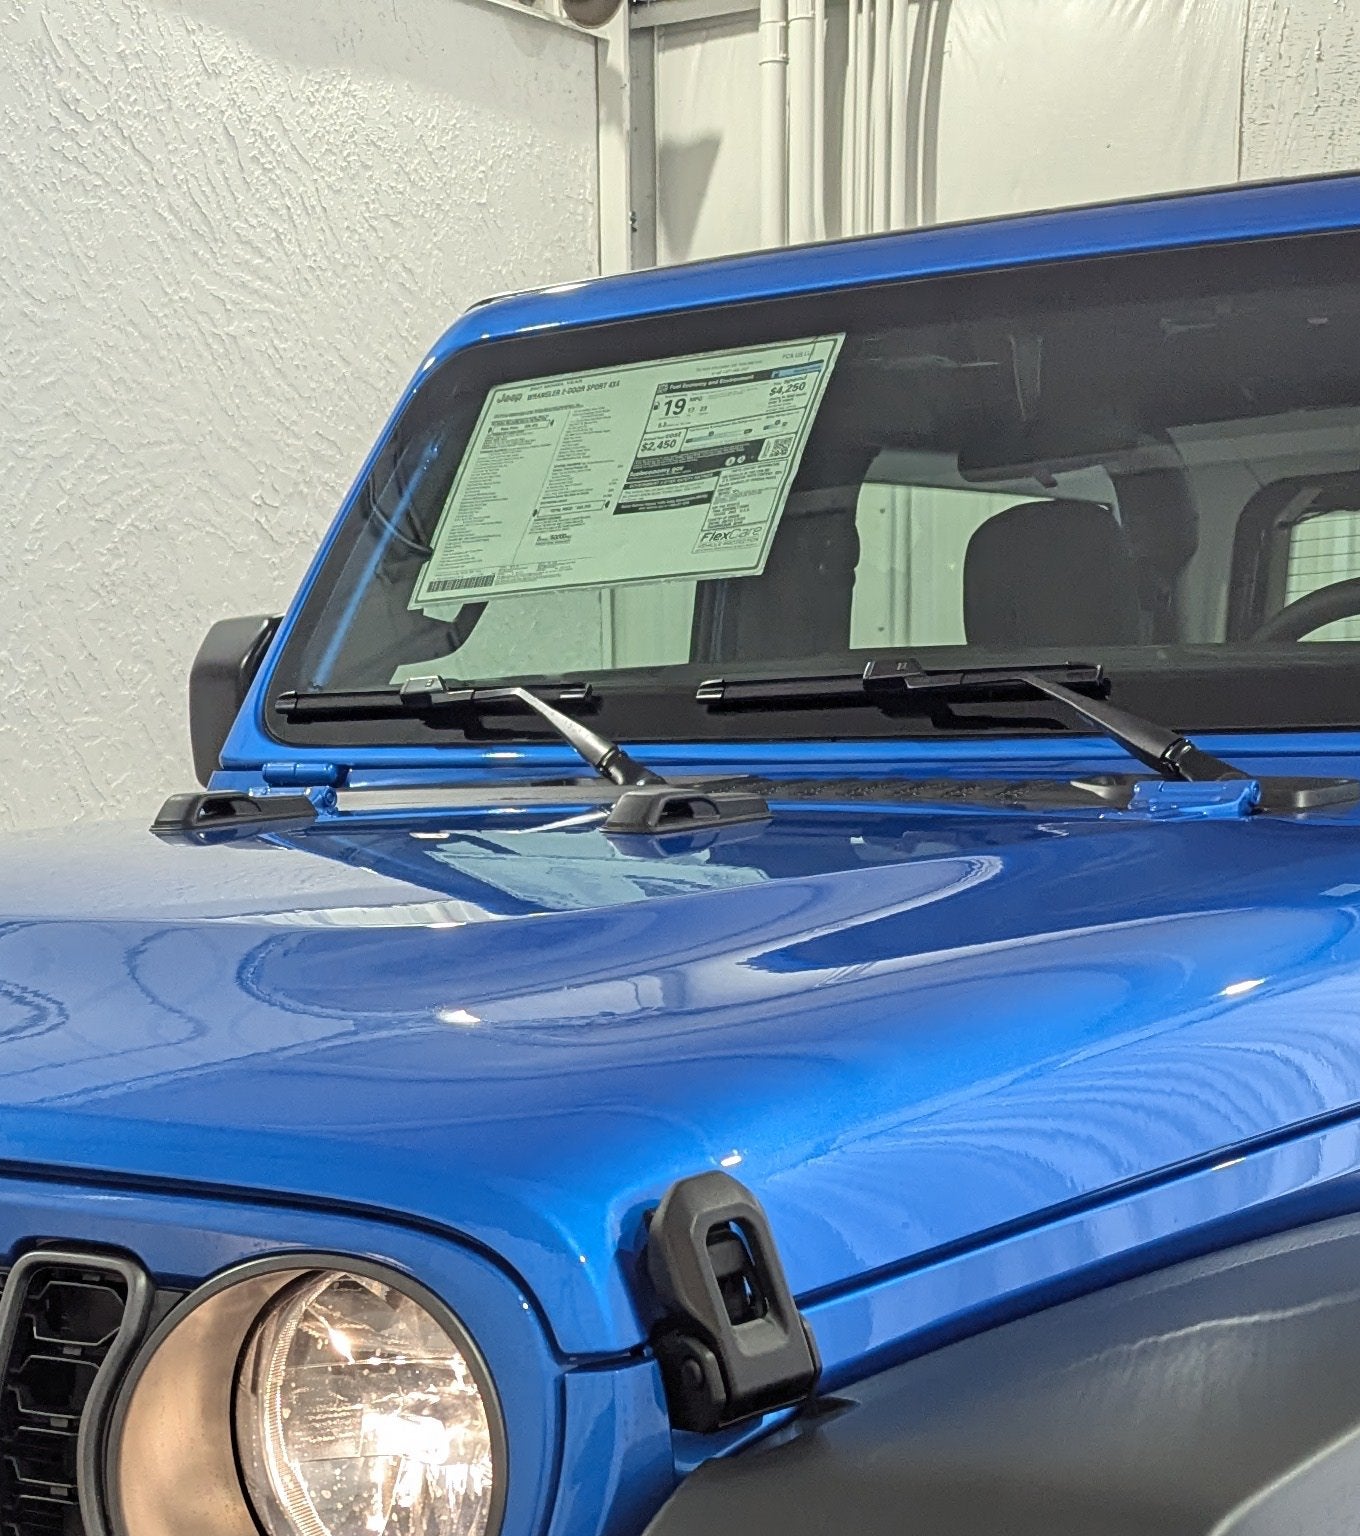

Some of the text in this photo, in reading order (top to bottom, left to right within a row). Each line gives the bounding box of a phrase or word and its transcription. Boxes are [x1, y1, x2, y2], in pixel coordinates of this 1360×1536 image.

[586, 382, 607, 392] SPORT
[769, 381, 806, 397] $4,250
[496, 393, 523, 404] Jeep
[664, 398, 687, 417] 19
[641, 439, 677, 452] $2,450
[700, 526, 763, 542] FlexCare
